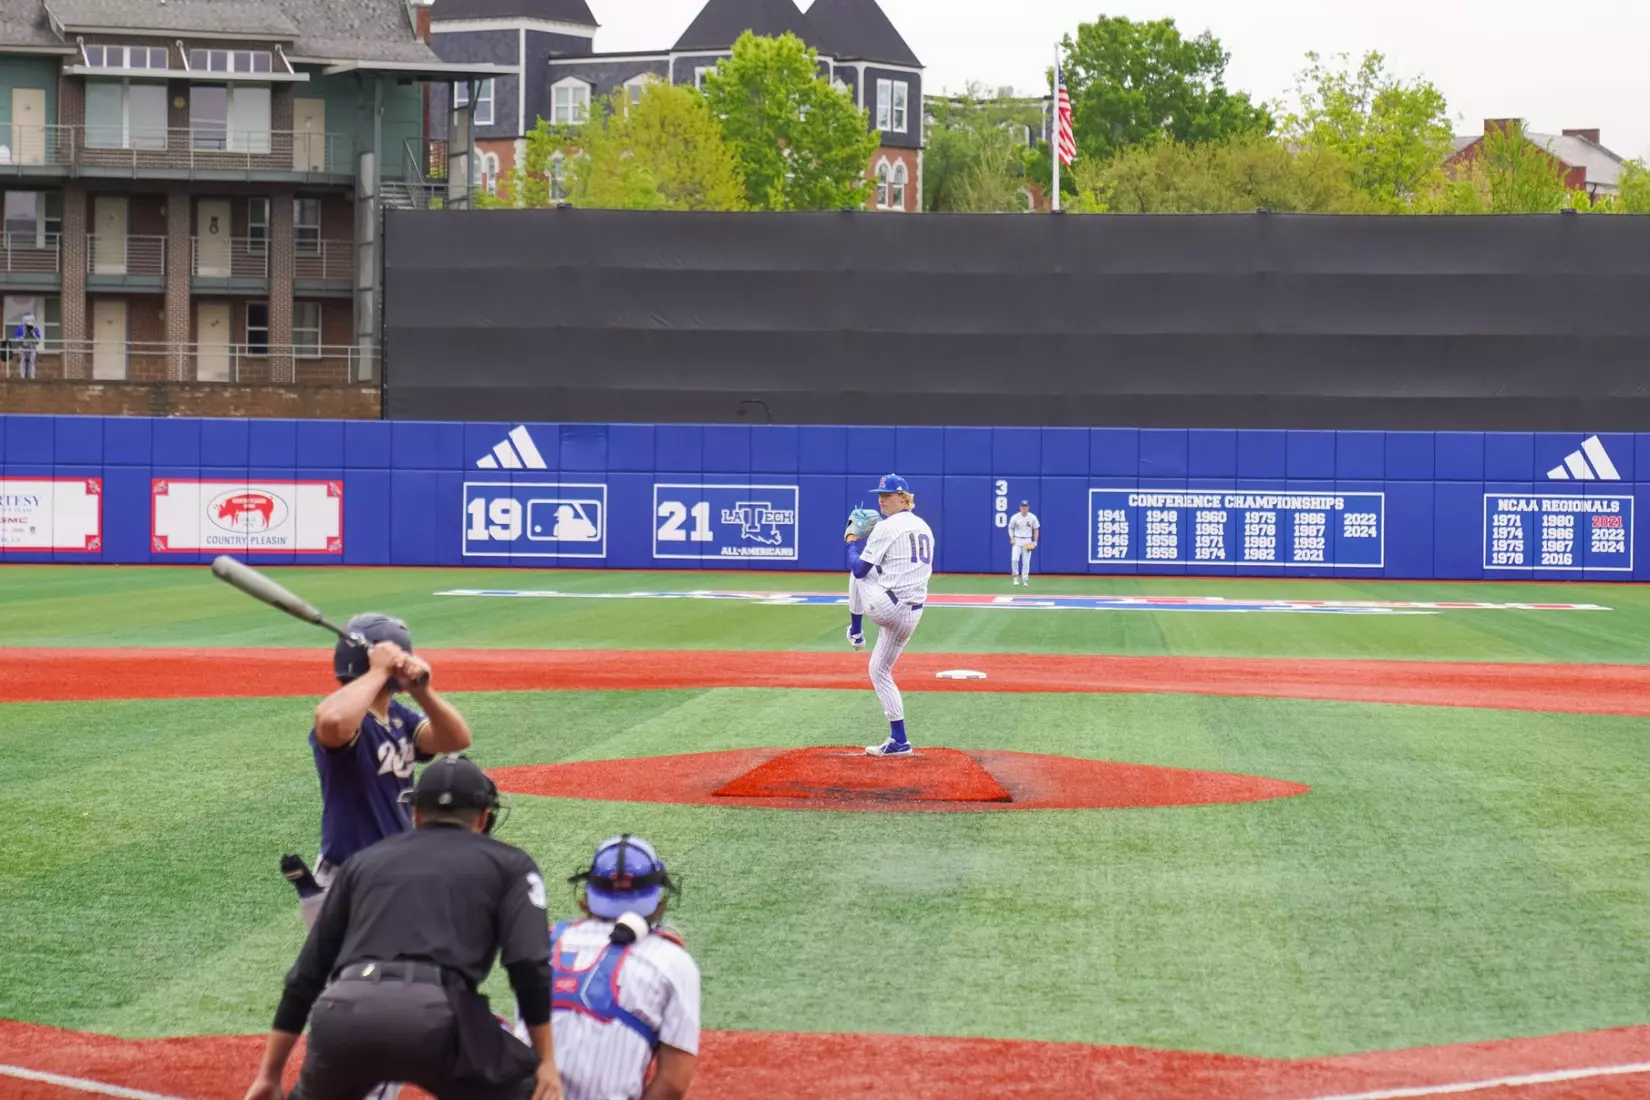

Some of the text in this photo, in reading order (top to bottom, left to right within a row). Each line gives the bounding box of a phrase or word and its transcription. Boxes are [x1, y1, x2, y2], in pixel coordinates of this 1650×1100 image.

[1128, 494, 1344, 510] CONFERENCE CHAMPIONSHIPS
[1498, 499, 1620, 512] NCAA REGIONALS
[468, 498, 522, 540] 19
[658, 501, 714, 542] 21
[1098, 510, 1126, 521] 1941
[1245, 512, 1276, 523] 1975
[1344, 514, 1376, 525] 2022
[1493, 514, 1521, 526] 1971
[1592, 516, 1623, 527] 2021
[1344, 526, 1377, 537] 2024
[1492, 528, 1523, 539] 1974
[1592, 529, 1625, 540] 2022
[206, 536, 248, 544] COUNTRY
[1196, 536, 1224, 547] 1971
[1492, 540, 1524, 552] 1975
[1592, 542, 1625, 552] 2024
[720, 547, 794, 556] ALL-AMERICANS
[909, 532, 930, 564] 10
[1097, 547, 1128, 558] 1947
[1195, 548, 1226, 559] 1974
[1293, 550, 1324, 561] 2021
[1542, 554, 1572, 565] 2016
